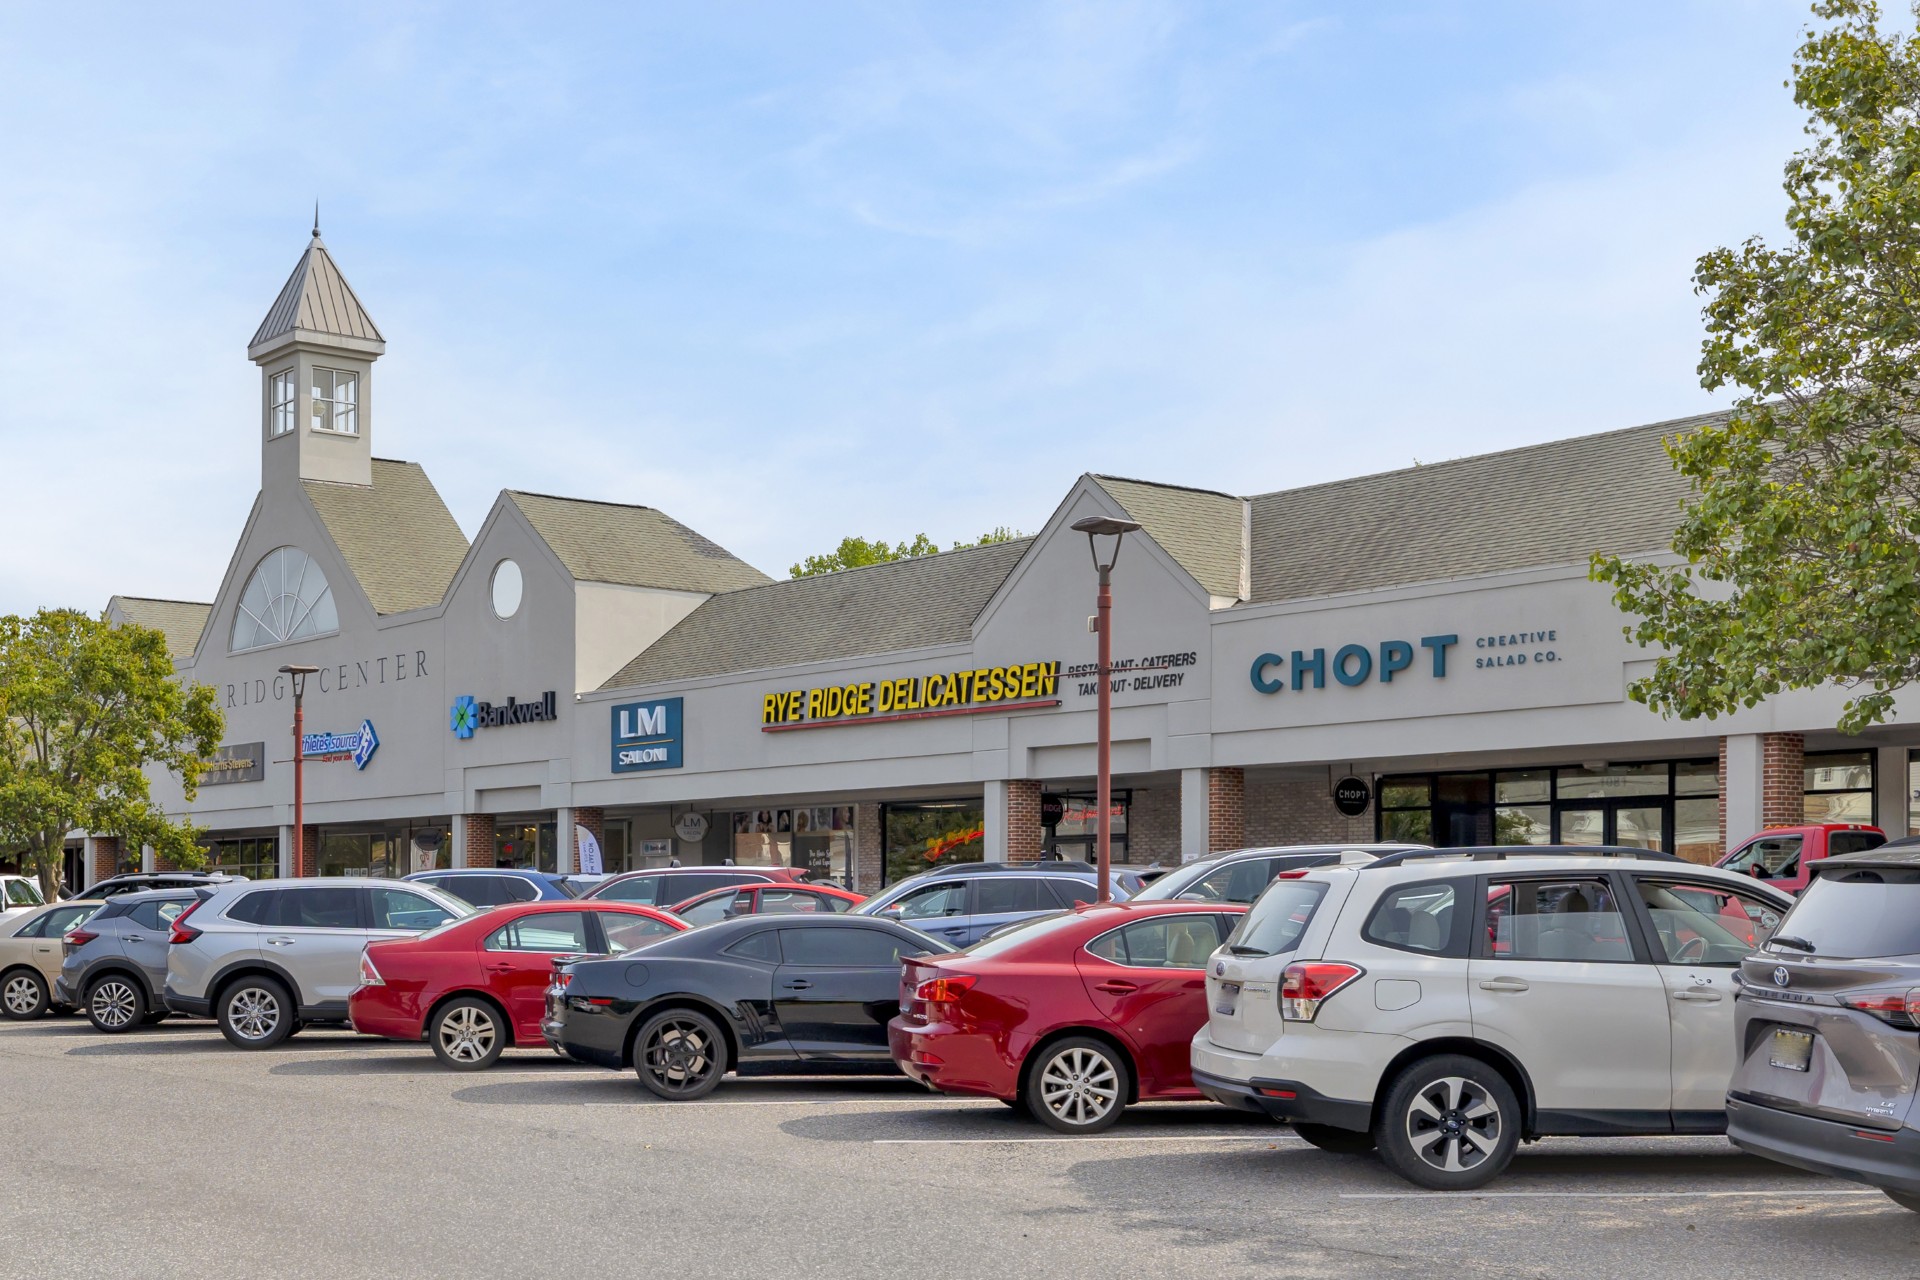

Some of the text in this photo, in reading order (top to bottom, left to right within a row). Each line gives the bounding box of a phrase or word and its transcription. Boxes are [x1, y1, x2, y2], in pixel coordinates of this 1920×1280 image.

[1476, 630, 1557, 648] CREATIVE
[1141, 651, 1197, 670] CATERERS
[1250, 634, 1458, 695] CHOPT
[1476, 650, 1562, 669] SALAD CO.
[319, 650, 428, 693] CENTER
[1133, 672, 1184, 691] DELIVERY
[762, 660, 1062, 723] RYE RIDGE DELICATESSEN
[478, 691, 557, 728] Bankwell
[620, 705, 667, 739] LM
[330, 735, 358, 749] source
[228, 758, 254, 770] Stevens
[619, 747, 667, 766] SALON
[1338, 790, 1367, 799] CHOPT
[683, 817, 701, 828] LM
